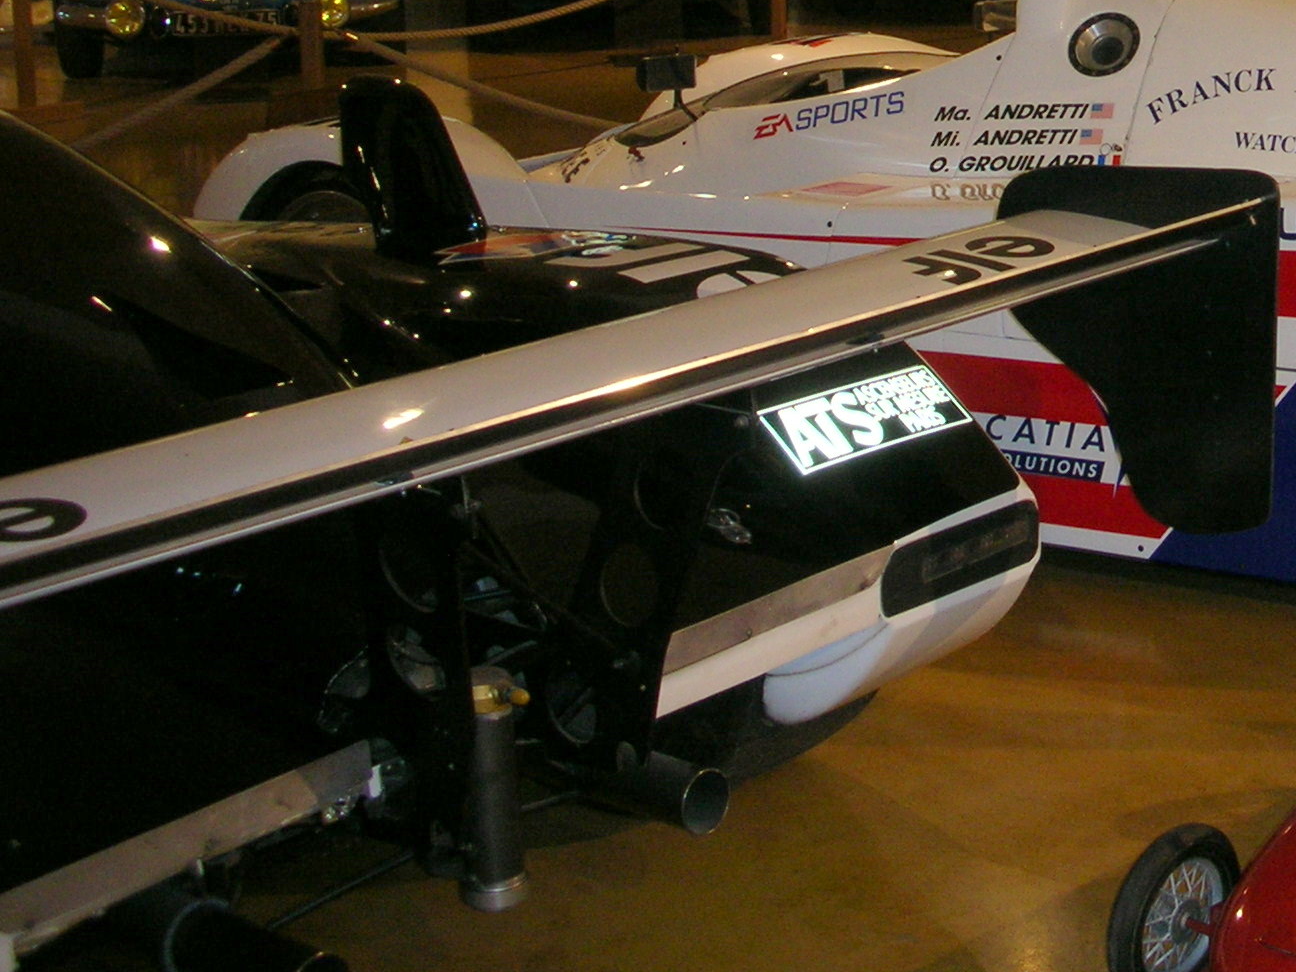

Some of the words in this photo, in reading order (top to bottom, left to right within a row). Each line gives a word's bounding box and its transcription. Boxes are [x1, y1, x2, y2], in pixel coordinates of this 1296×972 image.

[795, 91, 906, 132] SPORTS
[934, 106, 972, 122] Ma.
[983, 103, 1090, 120] ANDRETTI
[1146, 67, 1278, 126] FRANCK
[930, 131, 962, 147] Mi.
[972, 129, 1079, 146] ANDRETTI
[929, 156, 950, 173] O.
[958, 154, 1096, 173] GROUILLARD
[777, 391, 884, 468] ATS
[986, 414, 1105, 452] CATIA
[1003, 452, 1098, 478] OLUTIONS
